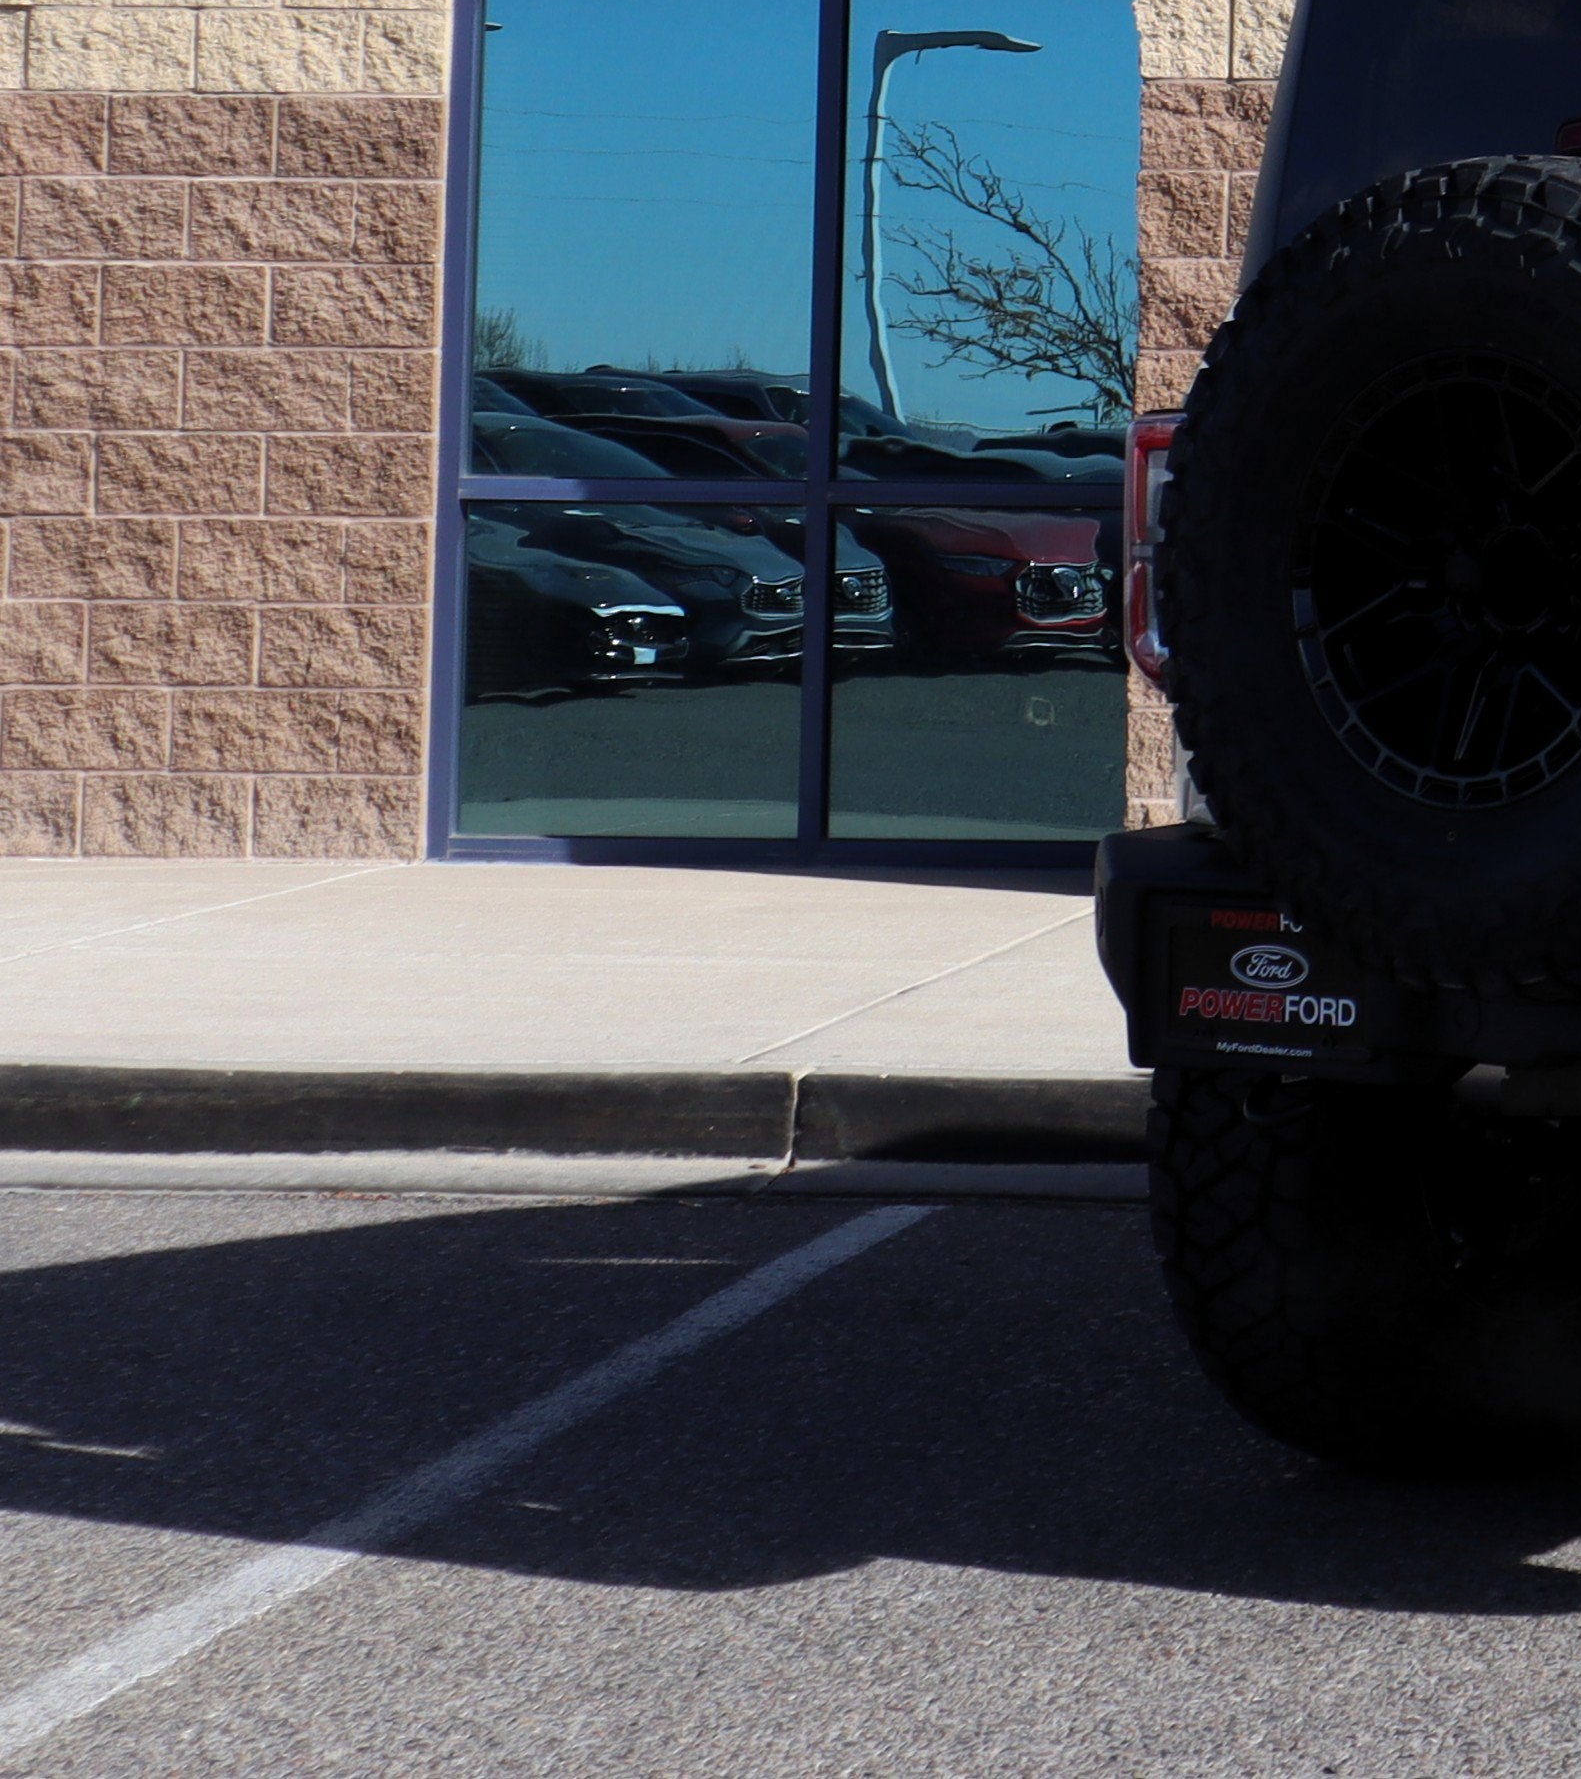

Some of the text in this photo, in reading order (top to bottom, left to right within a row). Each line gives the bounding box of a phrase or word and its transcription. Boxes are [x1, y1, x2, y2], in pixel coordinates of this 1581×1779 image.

[1246, 953, 1292, 980] Ford
[1179, 987, 1356, 1027] POWERFORD
[1216, 1041, 1313, 1058] MyFordDealer.com
